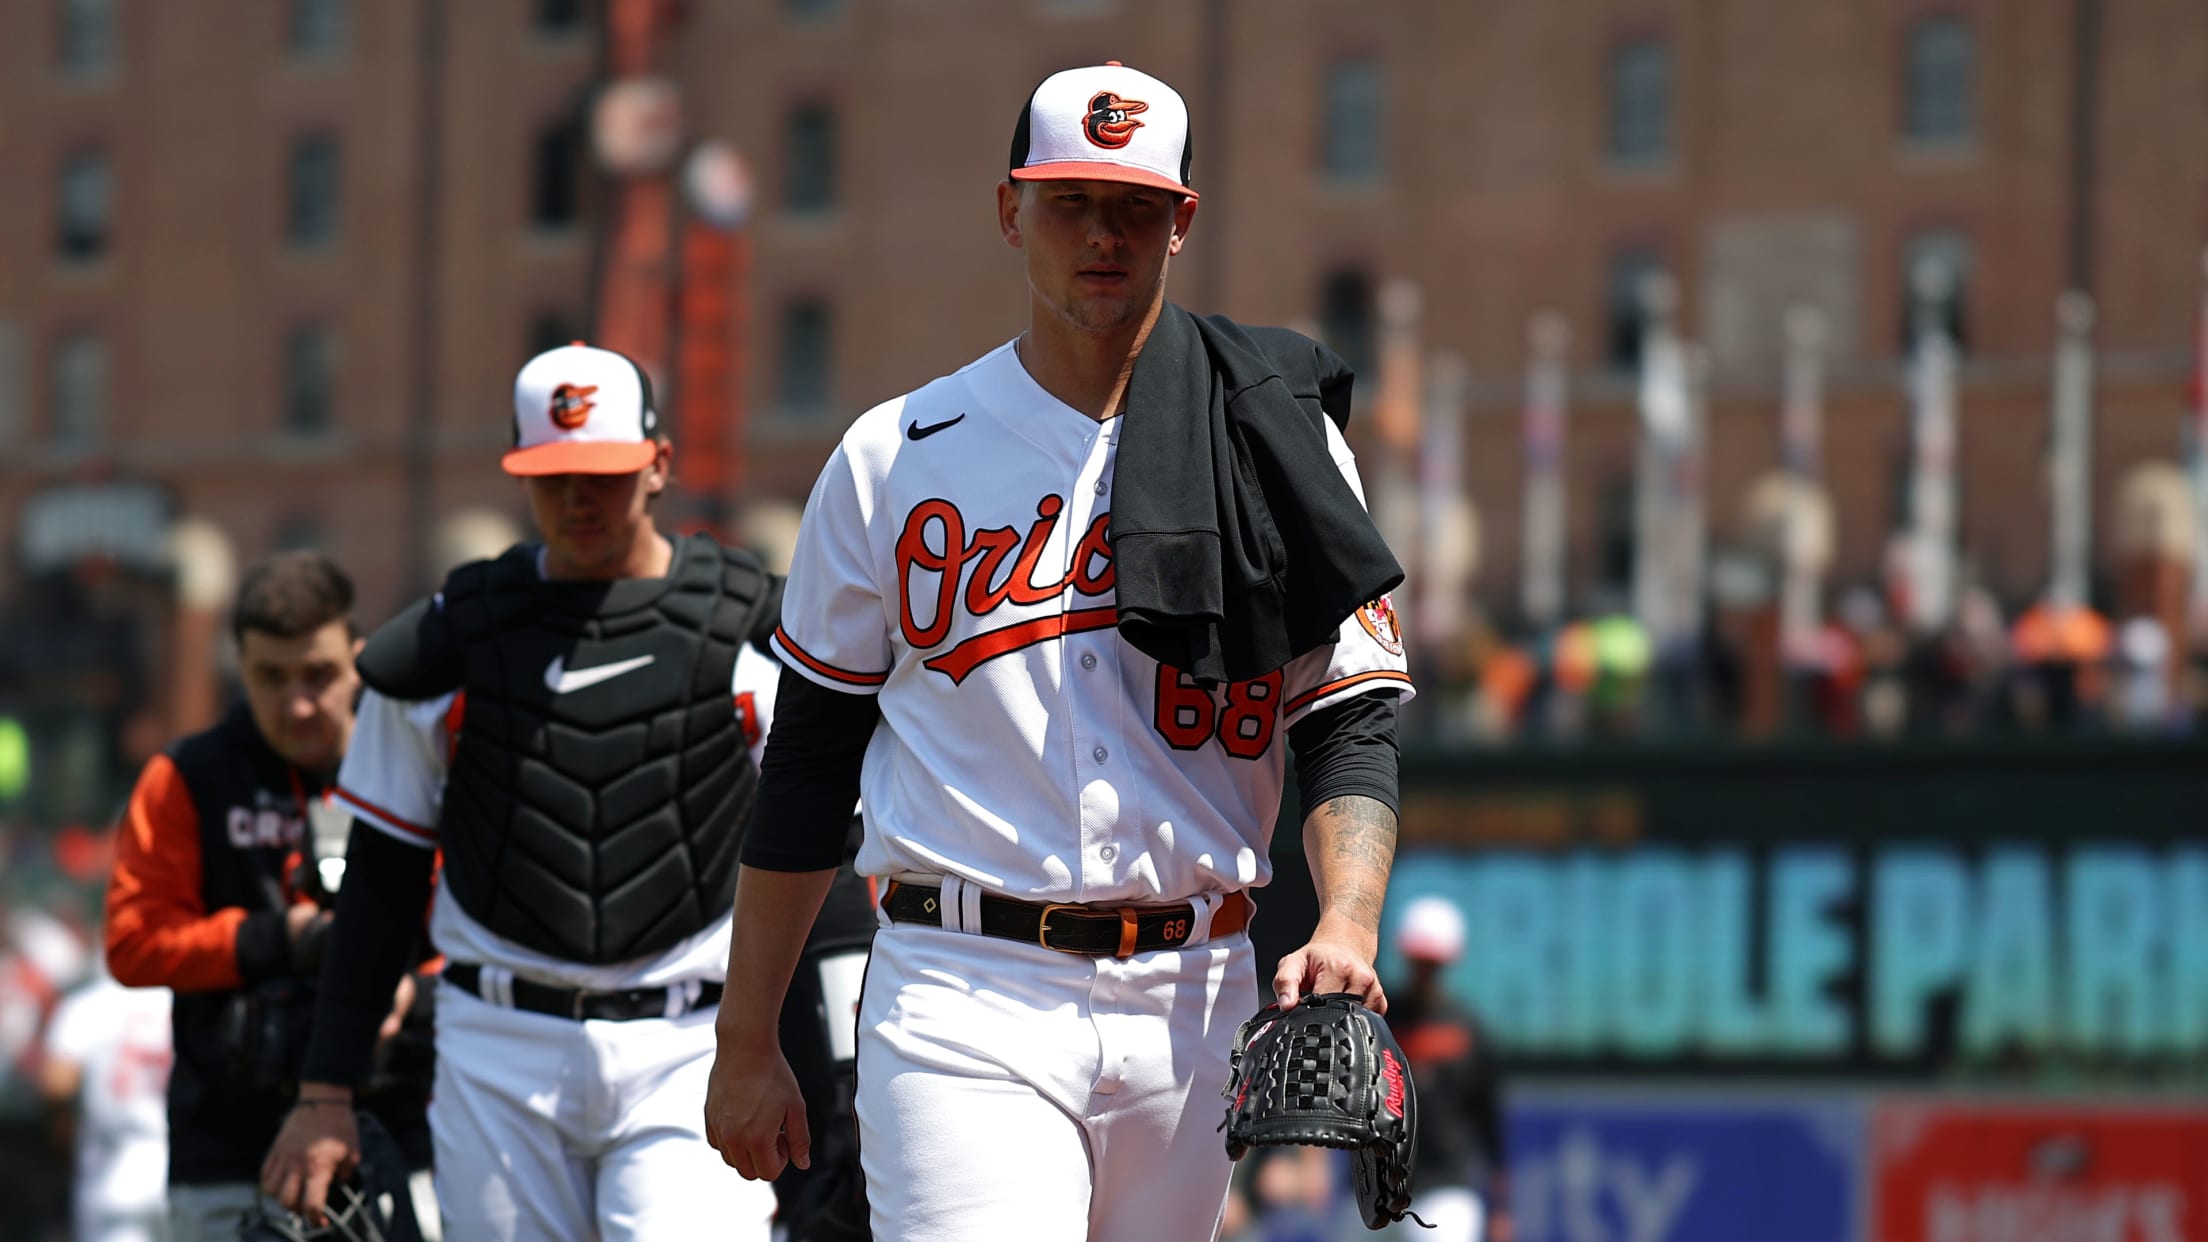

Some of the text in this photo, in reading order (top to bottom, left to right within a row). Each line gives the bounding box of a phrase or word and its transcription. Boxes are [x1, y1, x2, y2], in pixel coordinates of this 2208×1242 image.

[1154, 663, 1284, 761] 68
[1163, 919, 1186, 941] 68
[1382, 1048, 1403, 1118] Rawlings
